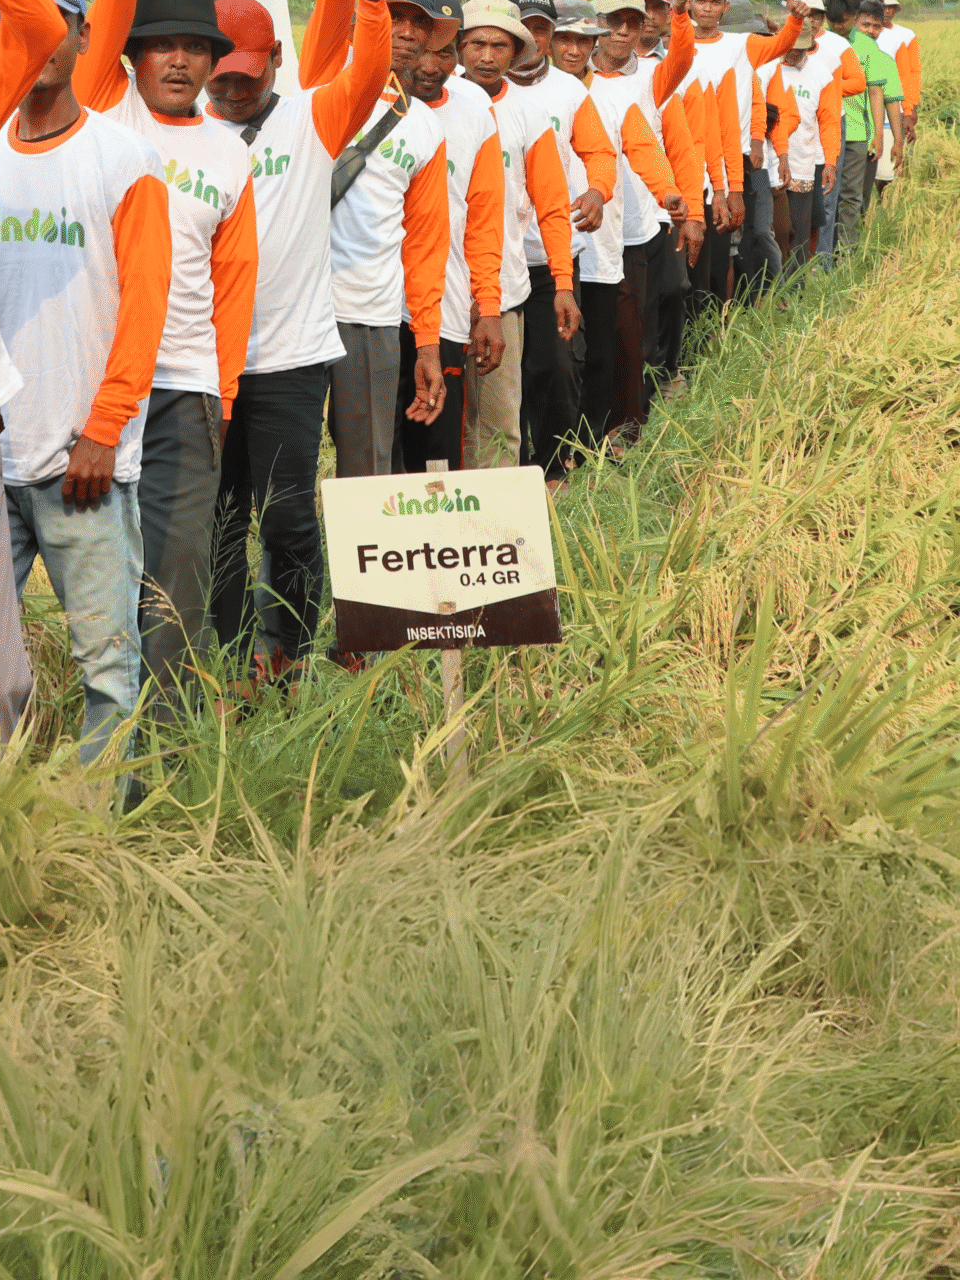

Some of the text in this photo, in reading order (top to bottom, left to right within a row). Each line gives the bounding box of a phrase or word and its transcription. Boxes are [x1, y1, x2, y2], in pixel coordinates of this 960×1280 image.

[459, 570, 521, 587] 0.4 GR
[406, 624, 487, 641] INSEKTISIDA
